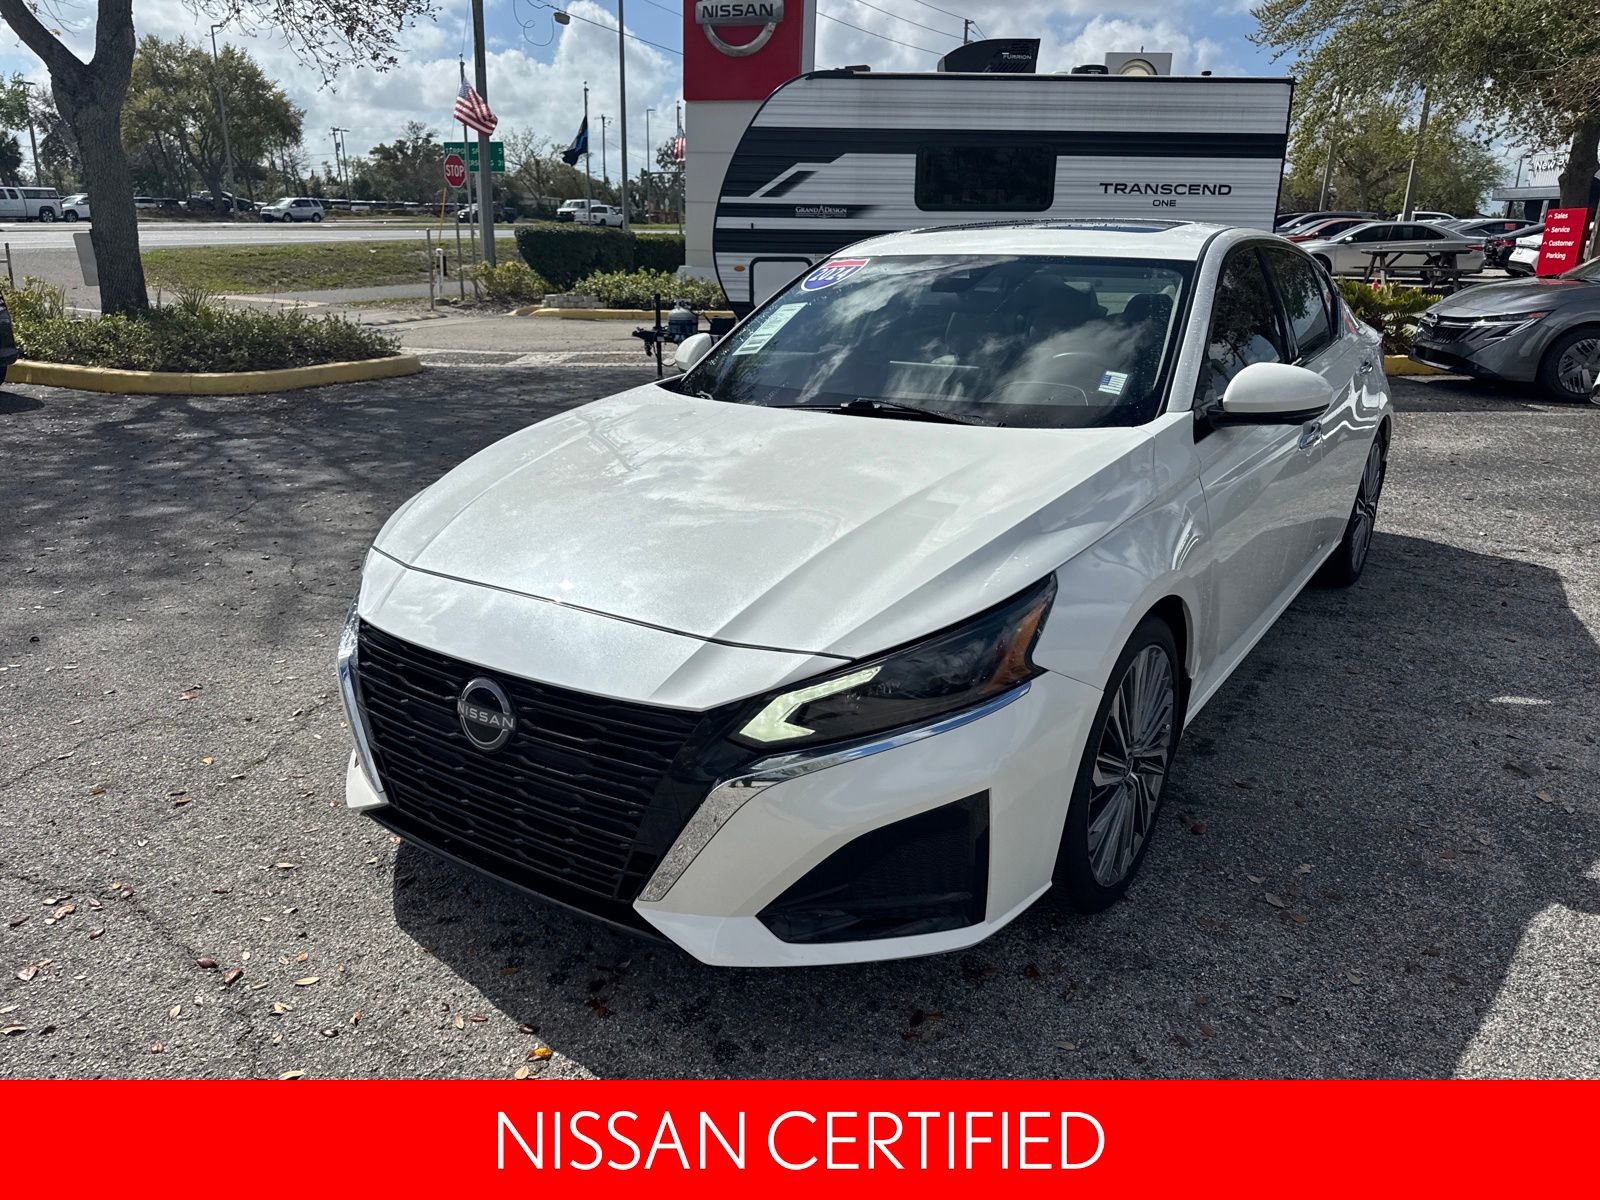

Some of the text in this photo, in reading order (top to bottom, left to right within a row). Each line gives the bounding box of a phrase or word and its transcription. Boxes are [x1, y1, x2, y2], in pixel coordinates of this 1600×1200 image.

[702, 3, 774, 18] NISSAN
[446, 164, 465, 177] STOP
[1536, 159, 1556, 170] New
[1099, 182, 1233, 196] TRANSCEND
[1152, 199, 1177, 208] ONE
[1551, 225, 1571, 233] Service
[1548, 239, 1575, 247] Customer
[1545, 252, 1567, 260] Parking
[808, 266, 857, 282] 2024
[457, 700, 514, 729] NISSAN
